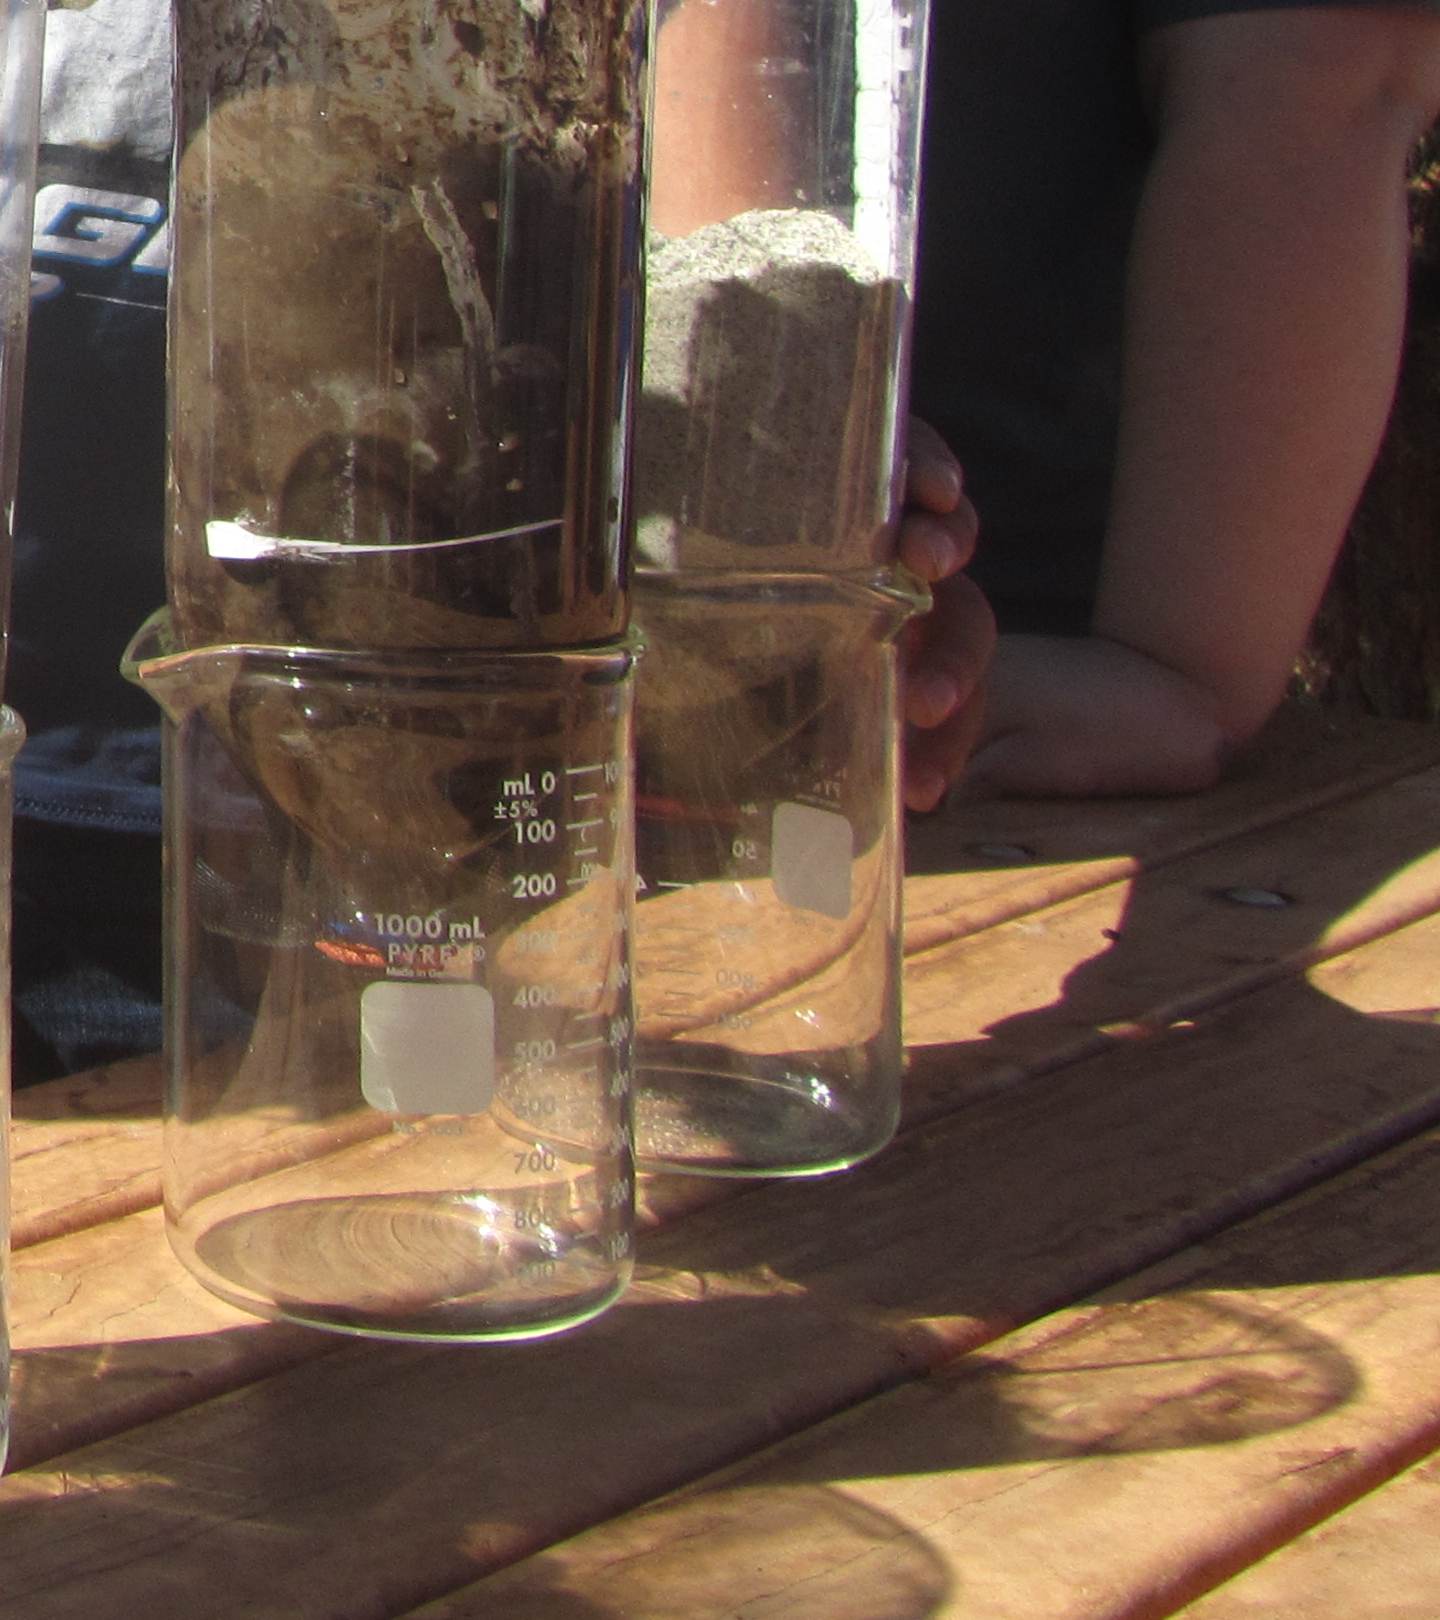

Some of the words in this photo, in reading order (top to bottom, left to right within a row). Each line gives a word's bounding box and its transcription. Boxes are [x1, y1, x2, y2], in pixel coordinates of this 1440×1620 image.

[503, 773, 535, 796] mL
[541, 771, 556, 794] 0
[494, 800, 538, 819] ±5%
[513, 819, 556, 844] 100
[512, 873, 556, 898] 200
[375, 913, 441, 937] 1000
[450, 916, 485, 939] mL
[512, 984, 557, 1009] 400
[513, 1039, 556, 1065] 500
[513, 1151, 556, 1174] 700
